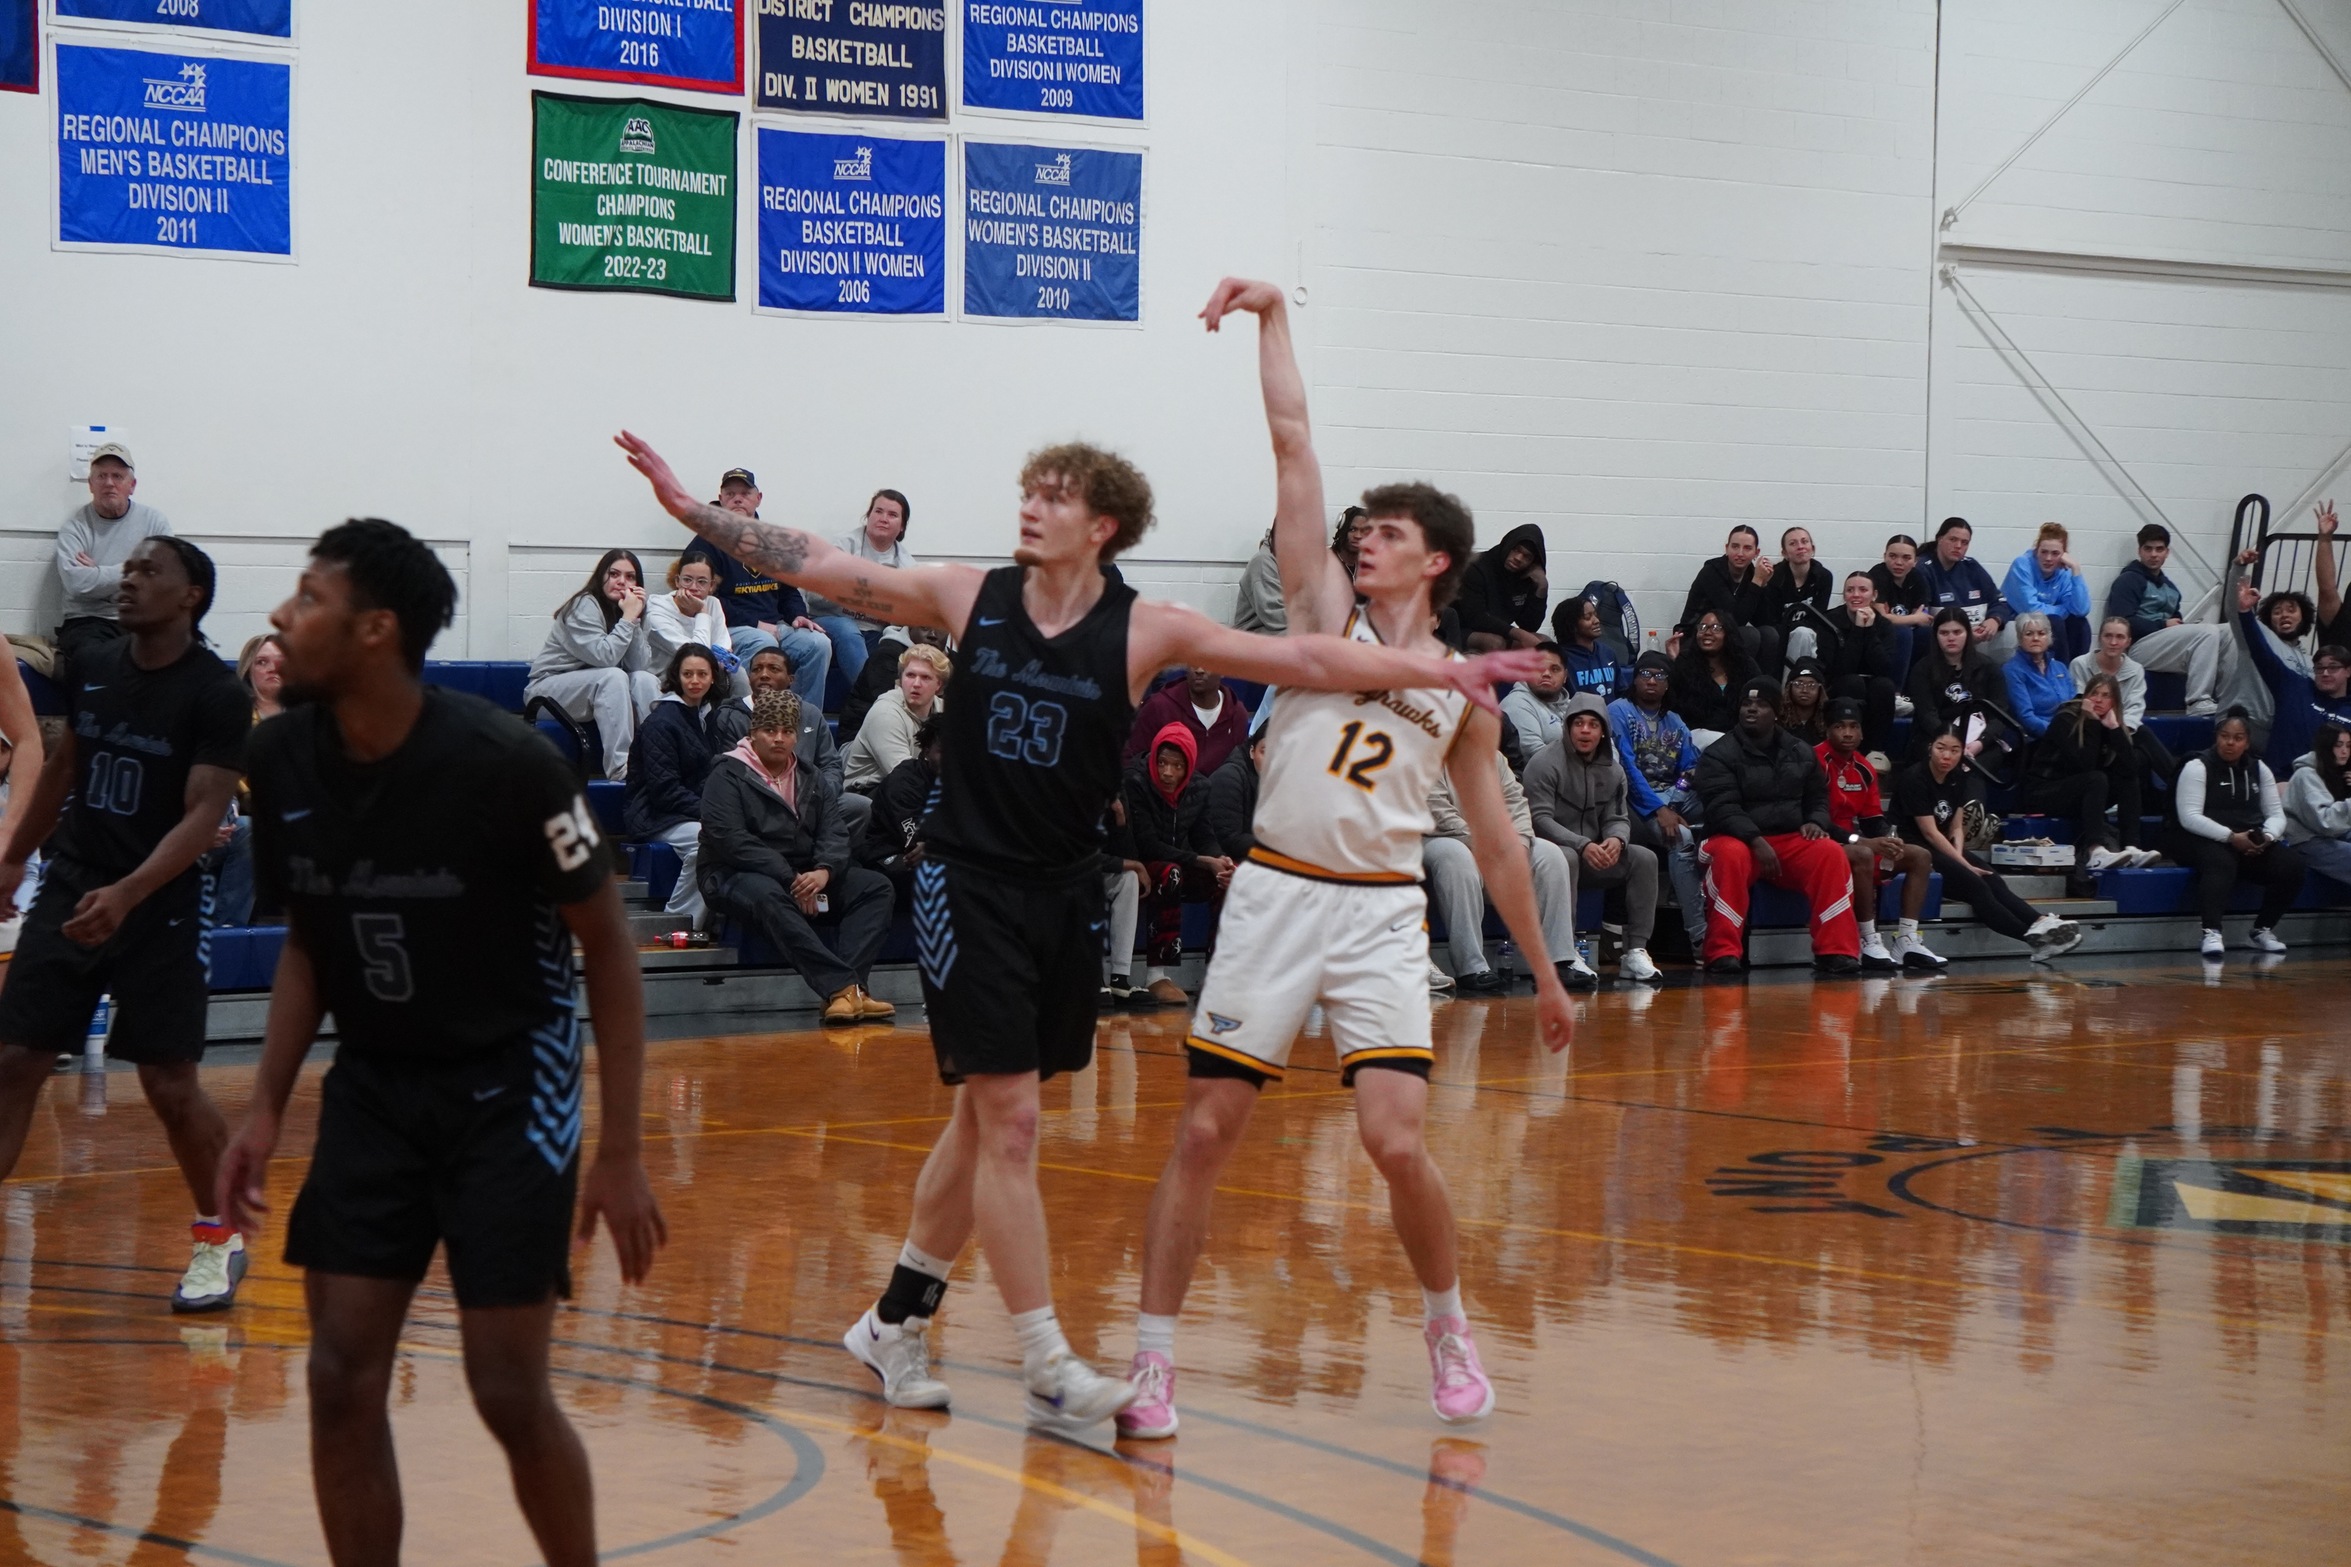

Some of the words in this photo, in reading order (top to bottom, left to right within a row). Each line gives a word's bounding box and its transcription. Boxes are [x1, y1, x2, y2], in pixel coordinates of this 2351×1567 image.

[157, 0, 199, 17] 2008
[599, 6, 671, 36] DIVISION
[676, 15, 682, 38] I
[758, 0, 833, 22] DISTRICT
[850, 2, 944, 31] CHAMPIONS
[970, 4, 1047, 28] REGIONAL
[1051, 9, 1138, 33] CHAMPIONS
[620, 40, 659, 67] 2016
[792, 34, 912, 68] BASKETBALL
[1007, 33, 1104, 57] BASKETBALL
[990, 59, 1053, 80] DIVISION
[1056, 62, 1062, 81] II
[1065, 63, 1120, 84] WOMEN
[144, 84, 206, 106] NCCAA
[765, 72, 796, 99] DIV.
[805, 76, 817, 100] II
[826, 78, 889, 106] WOMEN
[899, 84, 938, 109] 1991
[1041, 88, 1073, 107] 2009
[63, 114, 165, 145] REGIONAL
[171, 120, 285, 155] CHAMPIONS
[628, 120, 649, 134] AAC
[80, 148, 141, 176] MEN'S
[148, 151, 272, 185] BASKETBALL
[544, 158, 633, 185] CONFERENCE
[636, 163, 727, 196] TOURNAMENT
[834, 163, 870, 176] NCCAA
[1035, 168, 1070, 182] NCCAA
[129, 183, 211, 212] DIVISION
[217, 189, 228, 213] II
[597, 194, 675, 221] CHAMPIONS
[763, 186, 845, 214] REGIONAL
[850, 190, 942, 219] CHAMPIONS
[970, 188, 1046, 217] REGIONAL
[1050, 195, 1134, 225] CHAMPIONS
[157, 216, 197, 243] 2011
[559, 222, 623, 247] WOMEN'S
[627, 225, 712, 256] BASKETBALL
[802, 220, 904, 247] BASKETBALL
[968, 219, 1038, 247] WOMEN'S
[1043, 226, 1136, 255] BASKETBALL
[604, 255, 667, 280] 2022-23
[780, 249, 849, 275] DIVISION
[854, 251, 860, 274] II
[864, 252, 925, 277] WOMEN
[1016, 254, 1078, 280] DIVISION
[1083, 259, 1091, 281] II
[838, 280, 870, 303] 2006
[1037, 286, 1069, 310] 2010
[987, 691, 1067, 767] 23
[1327, 719, 1395, 794] 12
[86, 751, 143, 816] 10
[352, 912, 414, 1002] 5
